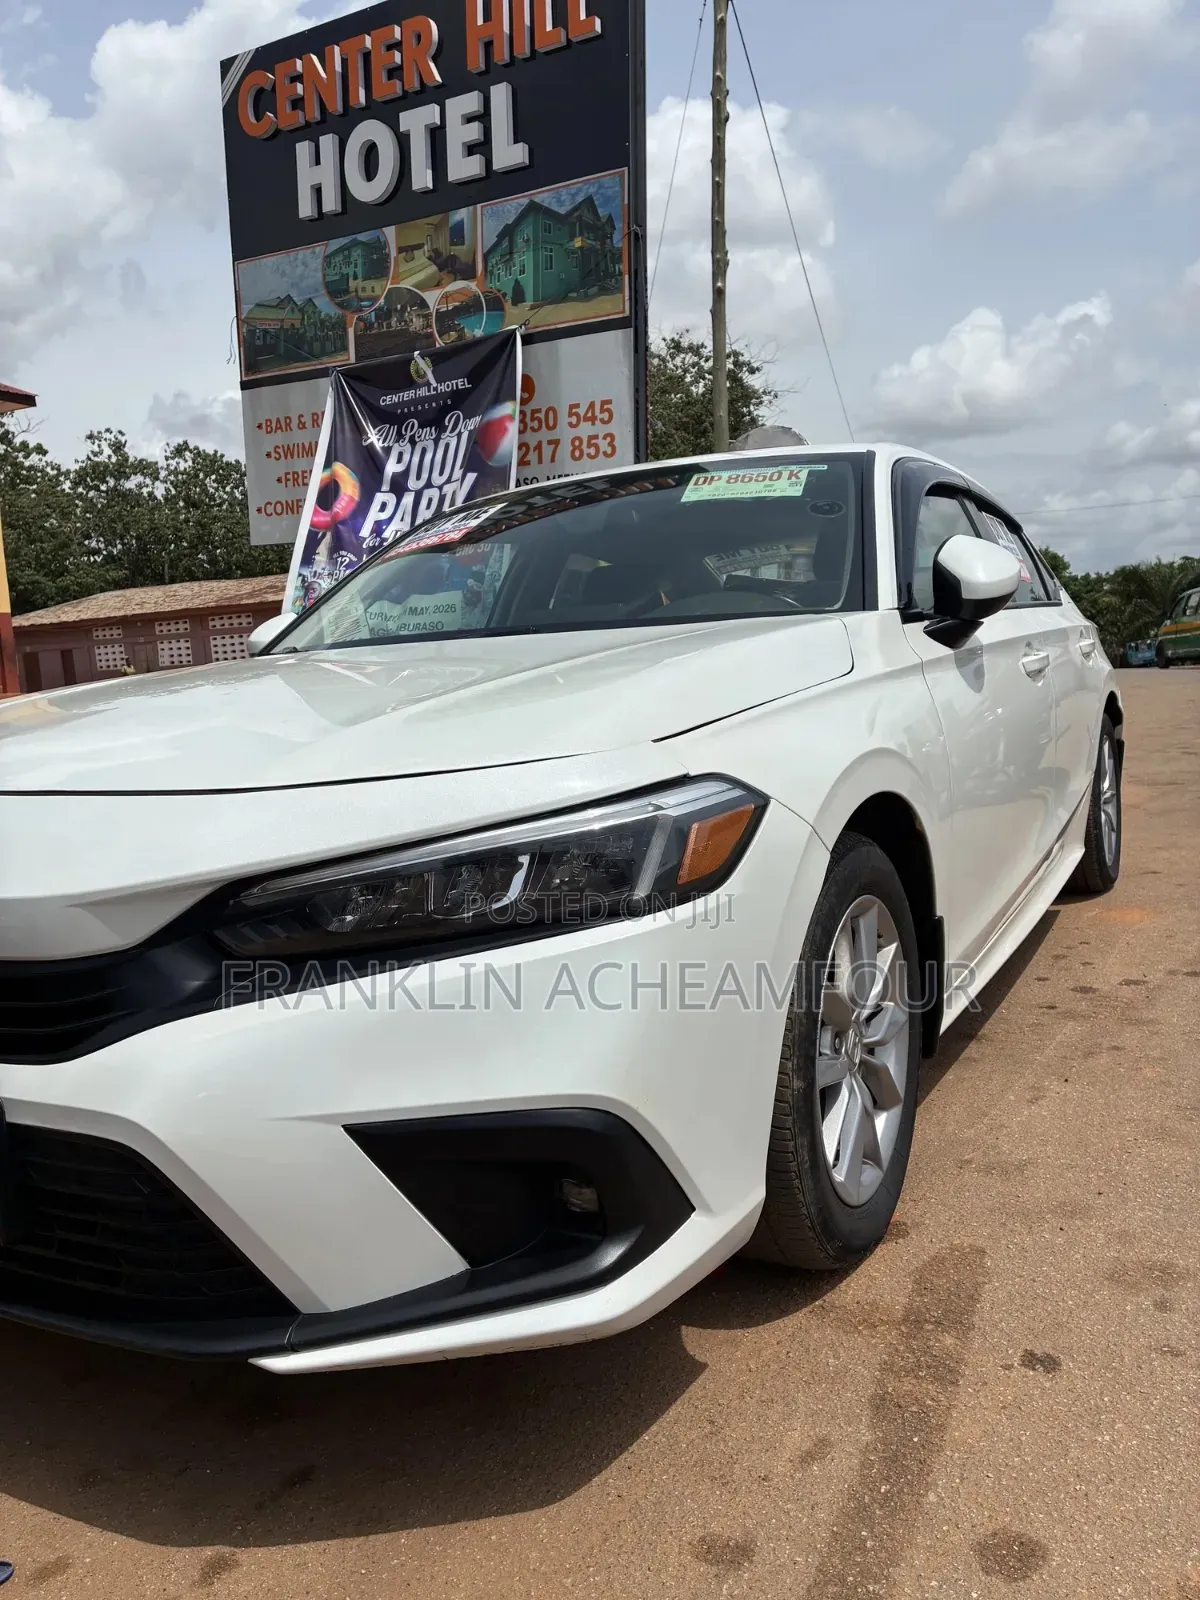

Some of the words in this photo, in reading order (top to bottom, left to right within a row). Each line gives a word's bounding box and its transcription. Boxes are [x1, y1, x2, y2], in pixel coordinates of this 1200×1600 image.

[238, 14, 443, 140] CENTER
[465, 0, 602, 73] HILL
[296, 82, 530, 221] HOTEL
[380, 390, 416, 406] CENTER
[416, 384, 437, 399] HILL
[437, 378, 472, 393] HOTEL
[397, 399, 452, 414] PRESENTS
[519, 406, 559, 435] 350
[567, 399, 614, 428] 545
[264, 415, 293, 434] BAR
[297, 413, 307, 431] &
[362, 423, 398, 447] All
[400, 418, 439, 447] Pens
[380, 430, 468, 491] POOL
[518, 438, 561, 467] 217
[570, 432, 617, 462] 853
[284, 470, 312, 488] FRE
[693, 474, 722, 487] DP
[726, 471, 782, 485] 8650
[787, 469, 804, 481] K
[263, 499, 306, 517] CONF
[359, 472, 478, 538] PARTY
[362, 533, 382, 549] for
[336, 556, 349, 570] 12
[432, 603, 457, 614] 2026
